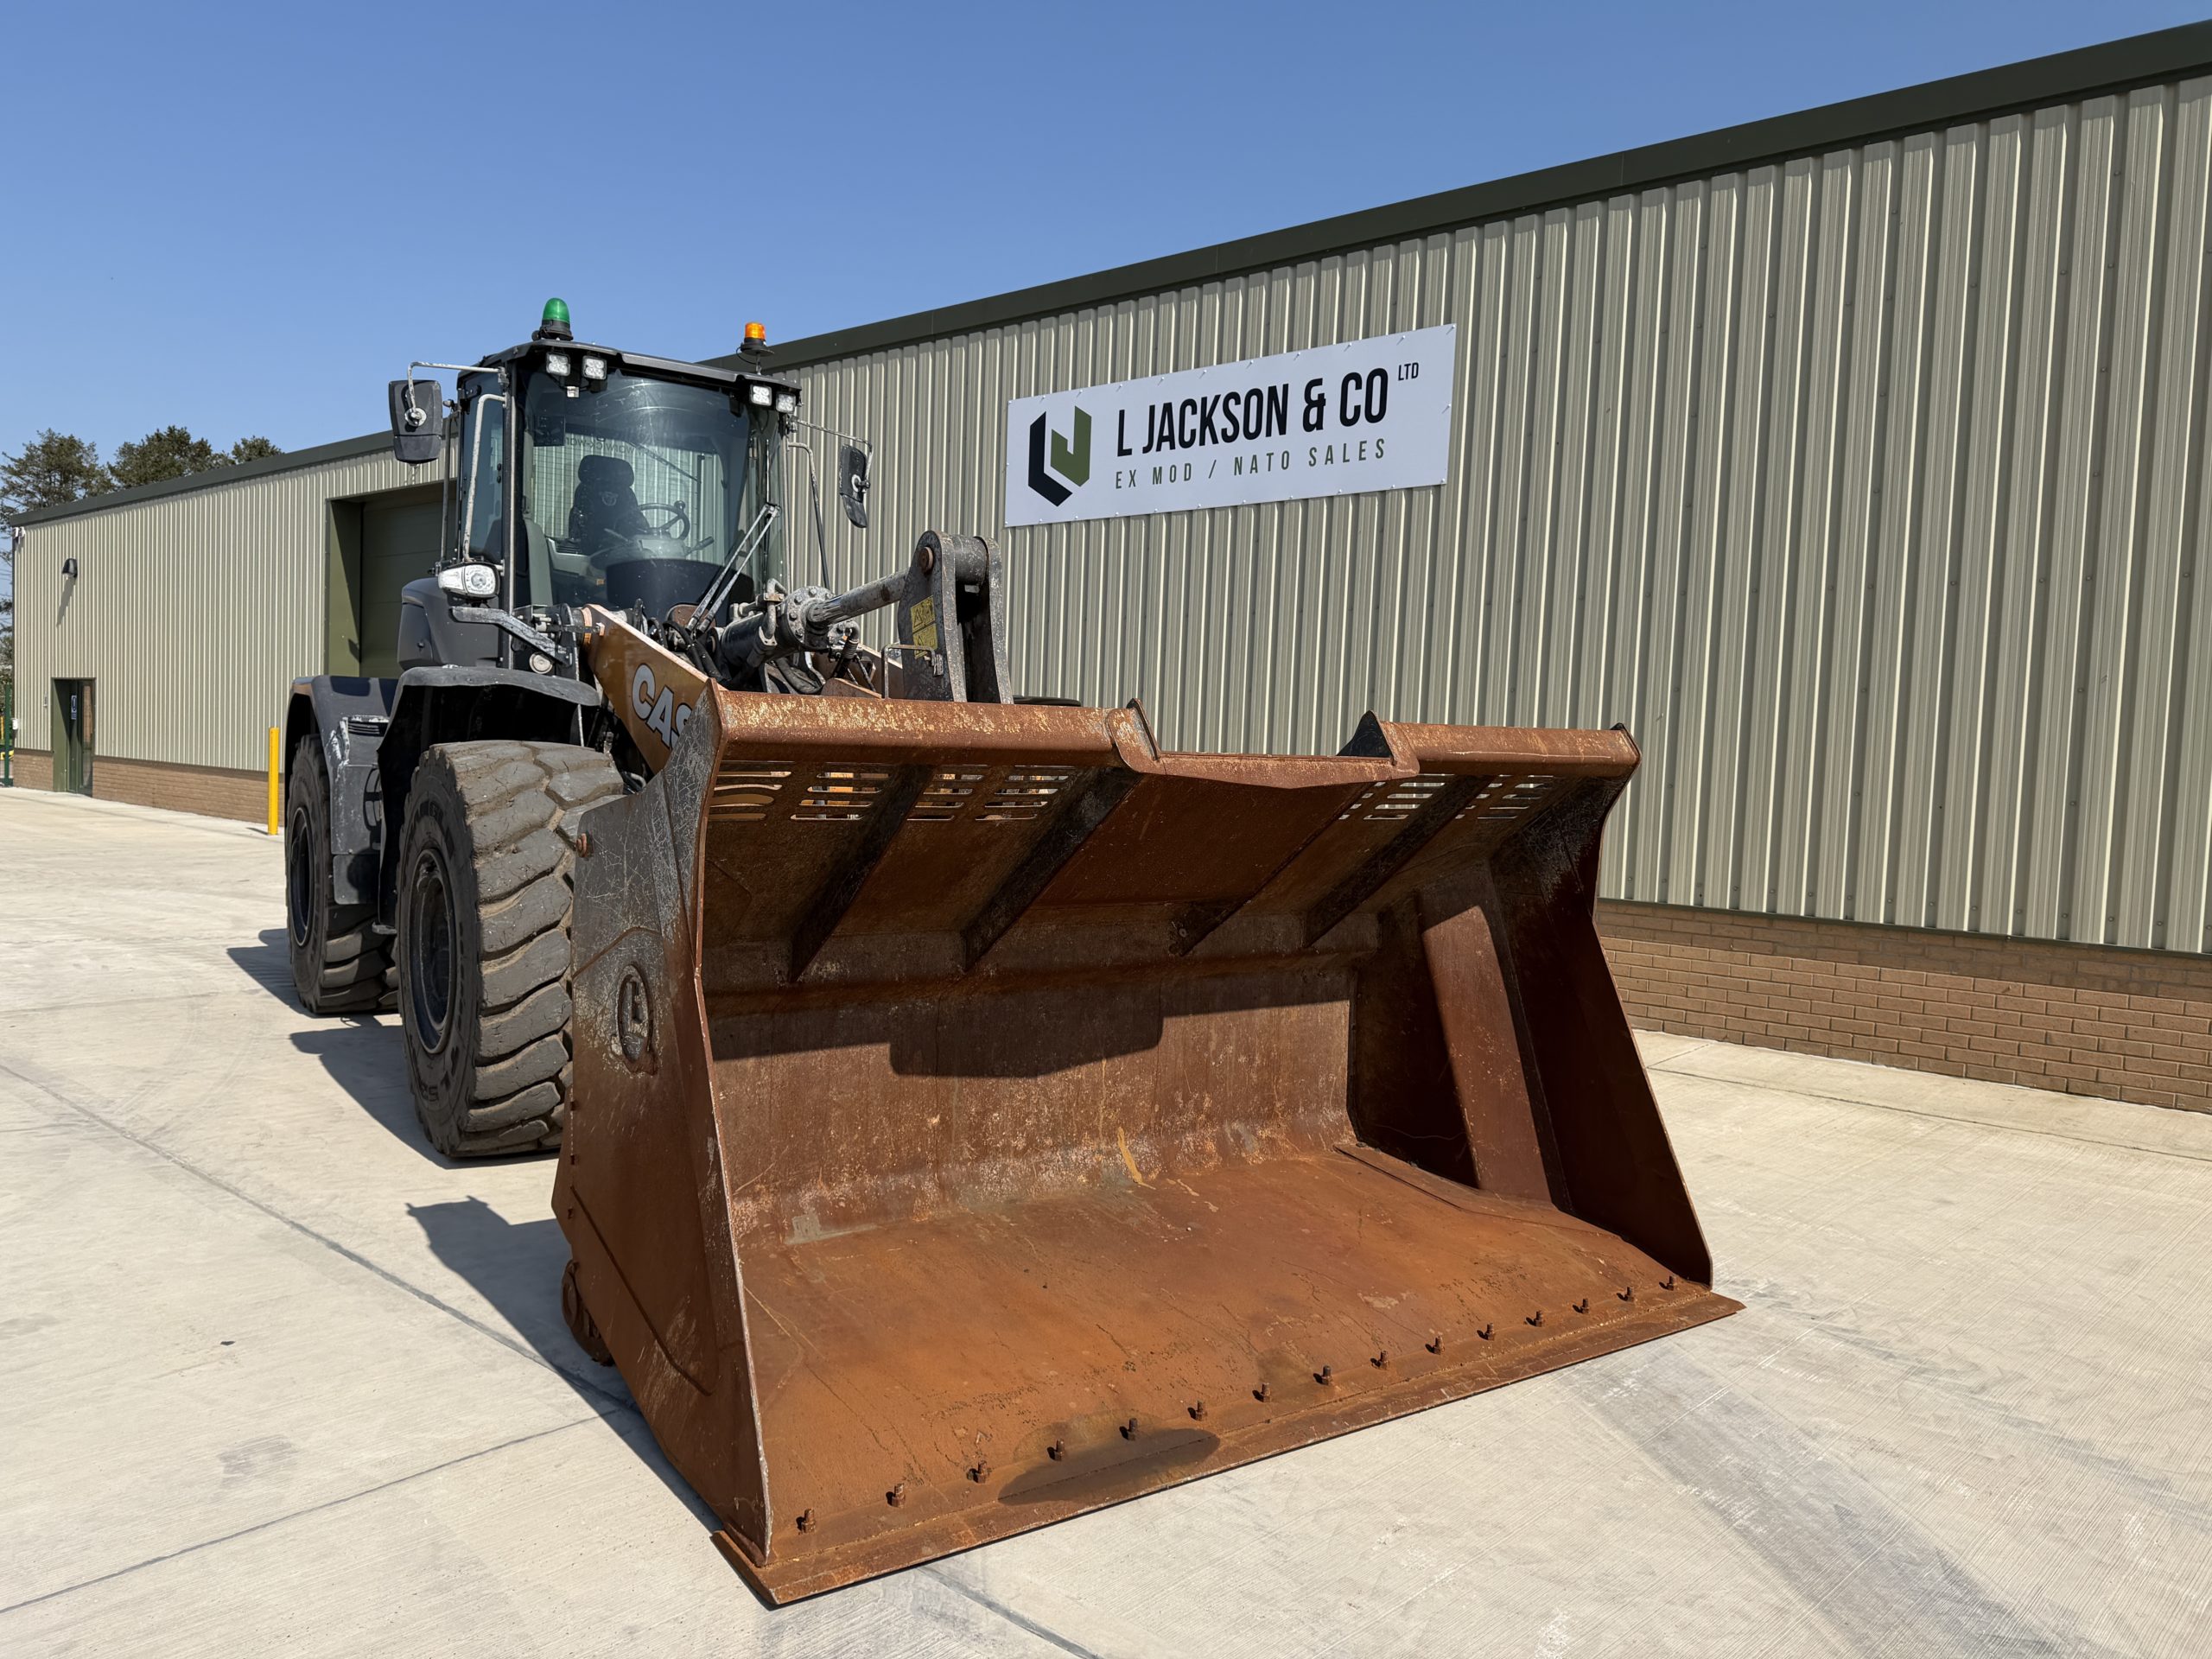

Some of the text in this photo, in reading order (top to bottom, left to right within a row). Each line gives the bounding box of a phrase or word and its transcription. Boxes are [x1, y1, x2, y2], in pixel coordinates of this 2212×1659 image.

[1116, 361, 1420, 458] L JACKSON & CO LTD
[1116, 469, 1136, 489] EX
[1152, 462, 1192, 486] MOD
[1234, 451, 1290, 476] NATO
[1309, 438, 1385, 467] SALES
